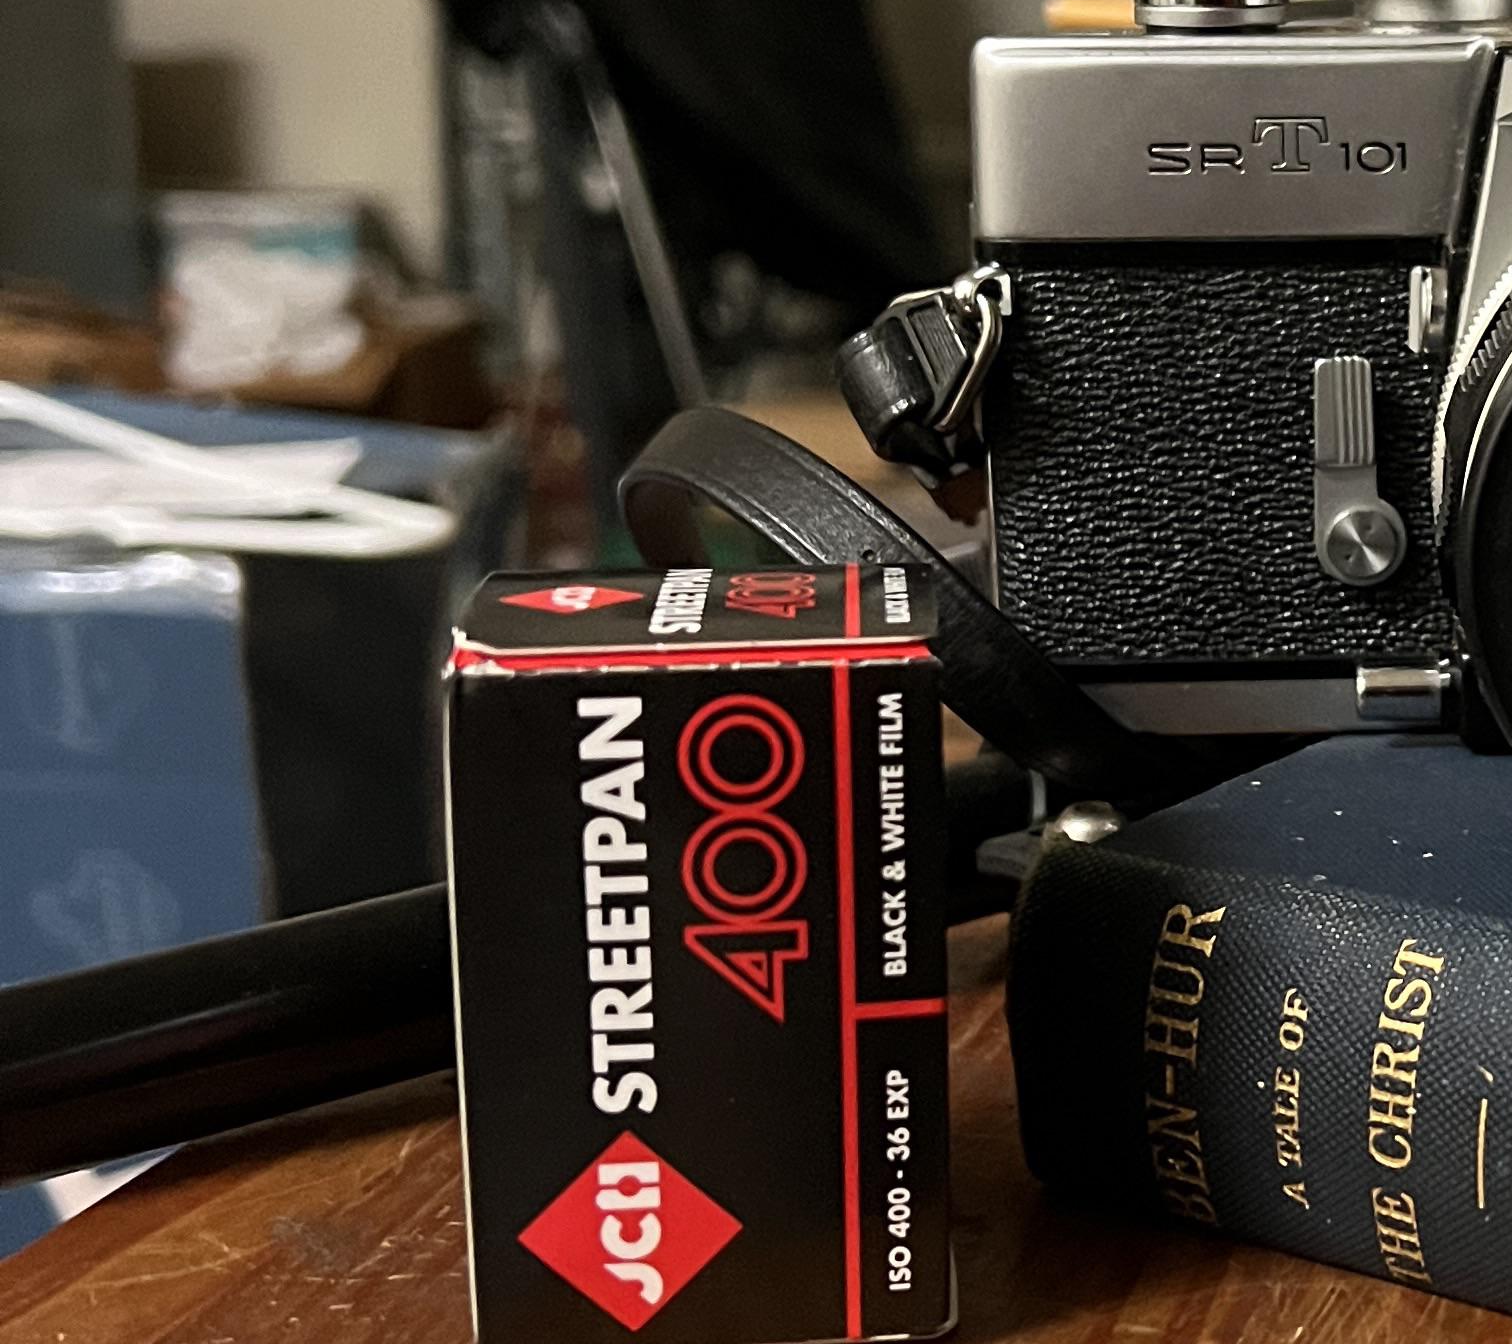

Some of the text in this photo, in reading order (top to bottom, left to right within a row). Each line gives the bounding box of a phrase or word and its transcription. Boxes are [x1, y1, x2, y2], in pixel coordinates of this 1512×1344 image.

[1339, 141, 1408, 175] 101
[647, 567, 715, 634] STREETPAN
[724, 572, 818, 620] 400
[676, 693, 809, 1024] 400
[877, 692, 907, 977] BLACK & WHITE FILM
[576, 696, 665, 1305] JCH STREETPAN
[886, 1069, 910, 1120] EXP
[1145, 904, 1227, 1228] BEN-HUR
[1273, 987, 1310, 1210] A TALE OF
[886, 1127, 910, 1162] 36
[1367, 938, 1445, 1286] THE CHRIST
[887, 1187, 911, 1238] 400
[888, 1245, 911, 1291] ISO
